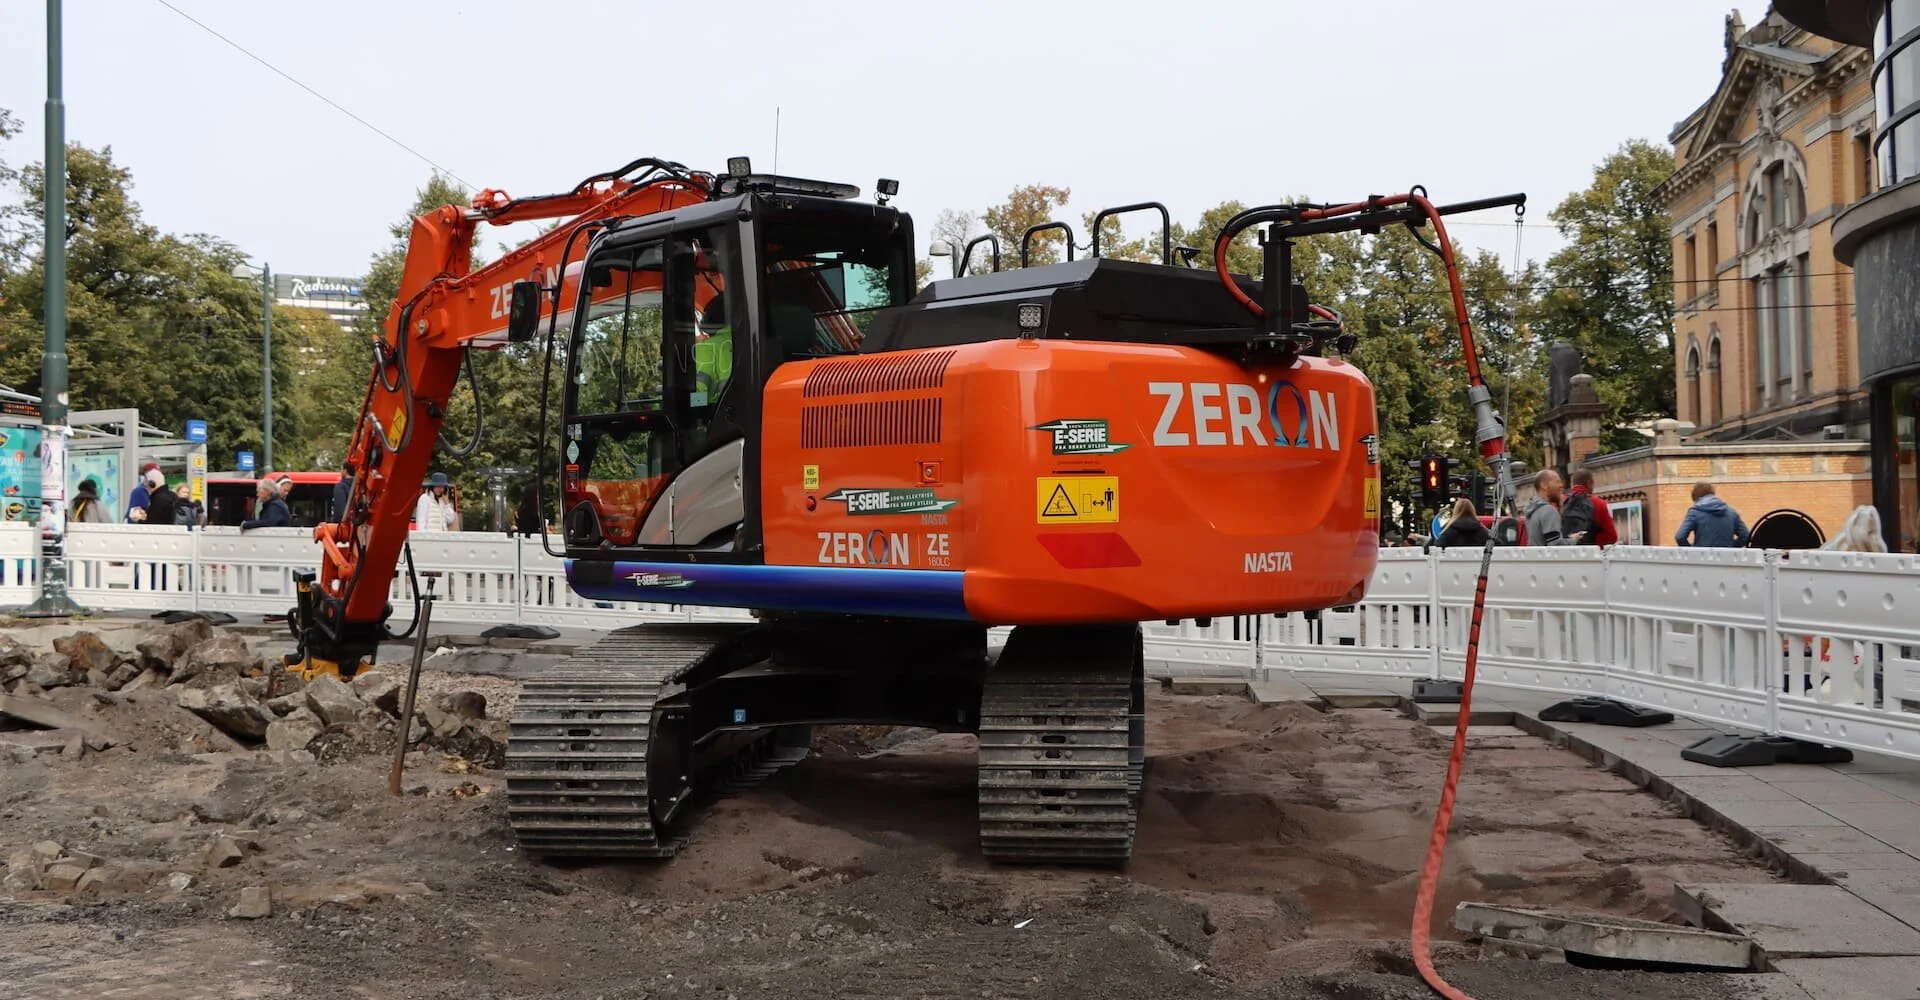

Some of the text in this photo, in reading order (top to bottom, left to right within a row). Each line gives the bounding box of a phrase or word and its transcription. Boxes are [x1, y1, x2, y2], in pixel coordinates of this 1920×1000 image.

[291, 278, 350, 298] Radisson
[1055, 428, 1106, 444] E-SERIE
[848, 491, 890, 512] E-SERIE
[921, 514, 947, 525] NASTA
[927, 533, 950, 556] ZE
[927, 556, 951, 567] 160LC
[1244, 551, 1293, 573] NASTA
